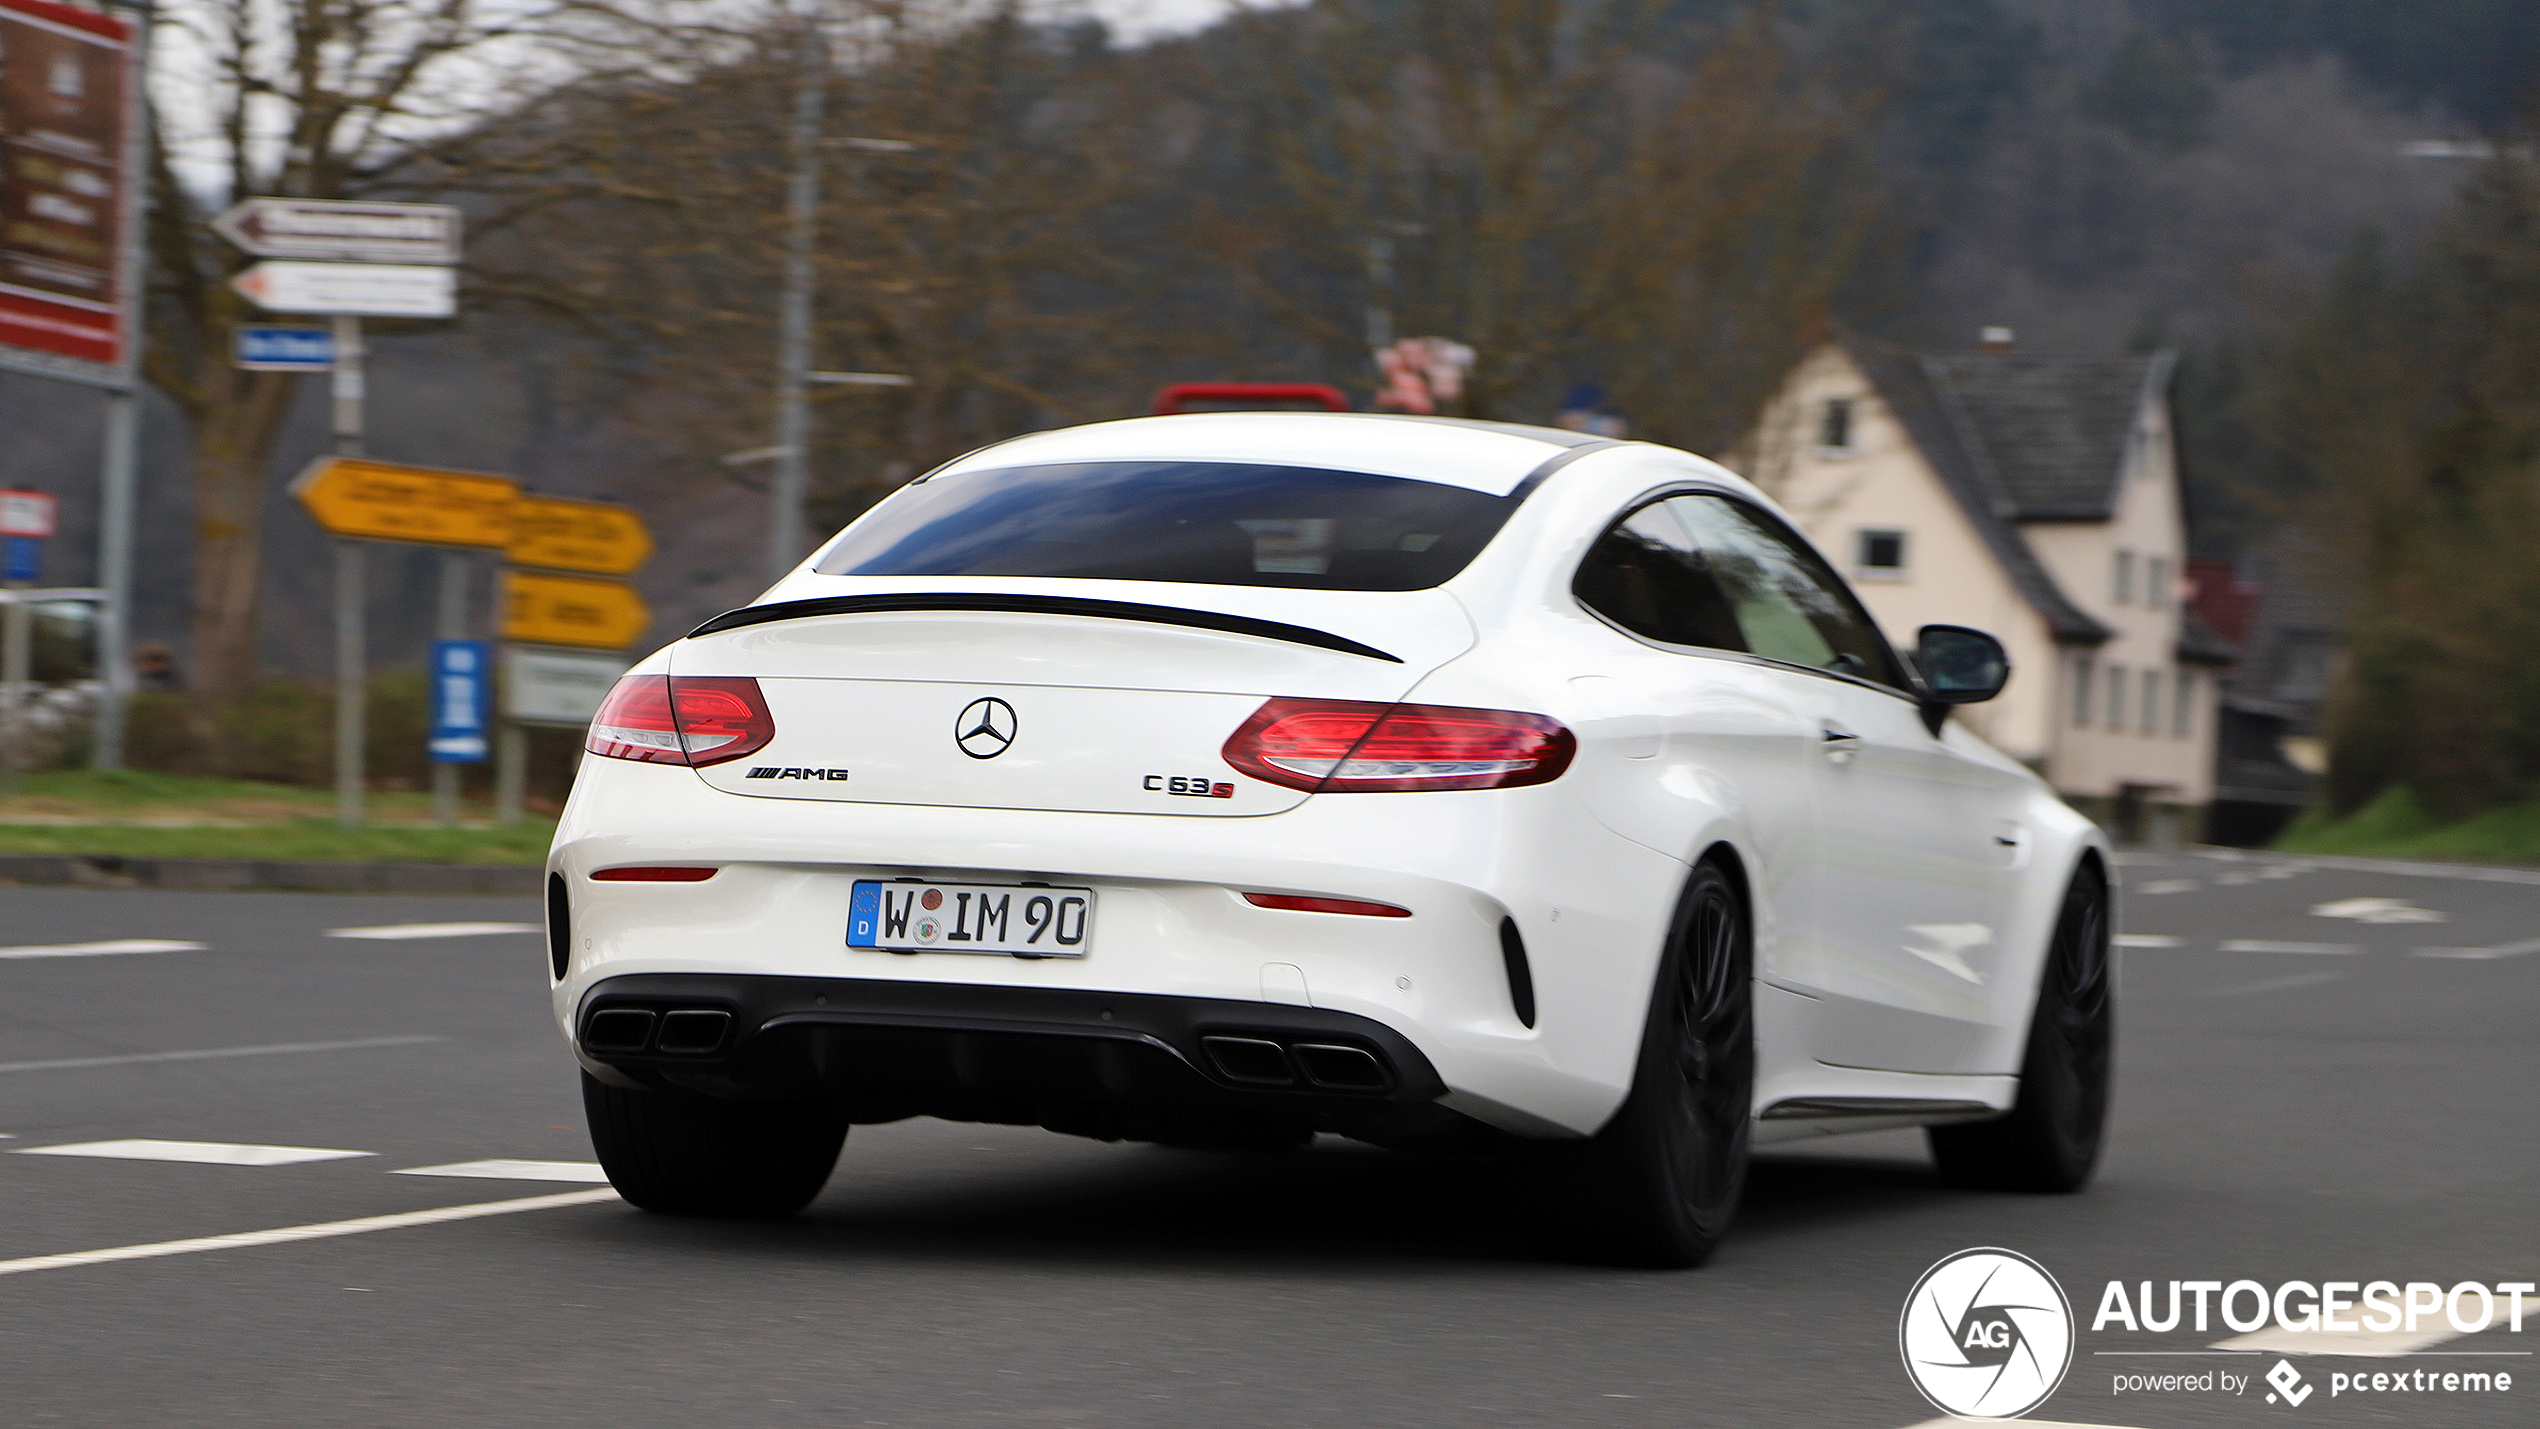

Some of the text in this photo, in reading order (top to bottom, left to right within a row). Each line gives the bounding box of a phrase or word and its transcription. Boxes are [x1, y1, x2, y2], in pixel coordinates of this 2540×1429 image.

[778, 767, 848, 780] AMG
[885, 890, 914, 938] W
[948, 893, 1010, 942] IM
[1025, 896, 1086, 945] 90
[857, 920, 869, 935] D
